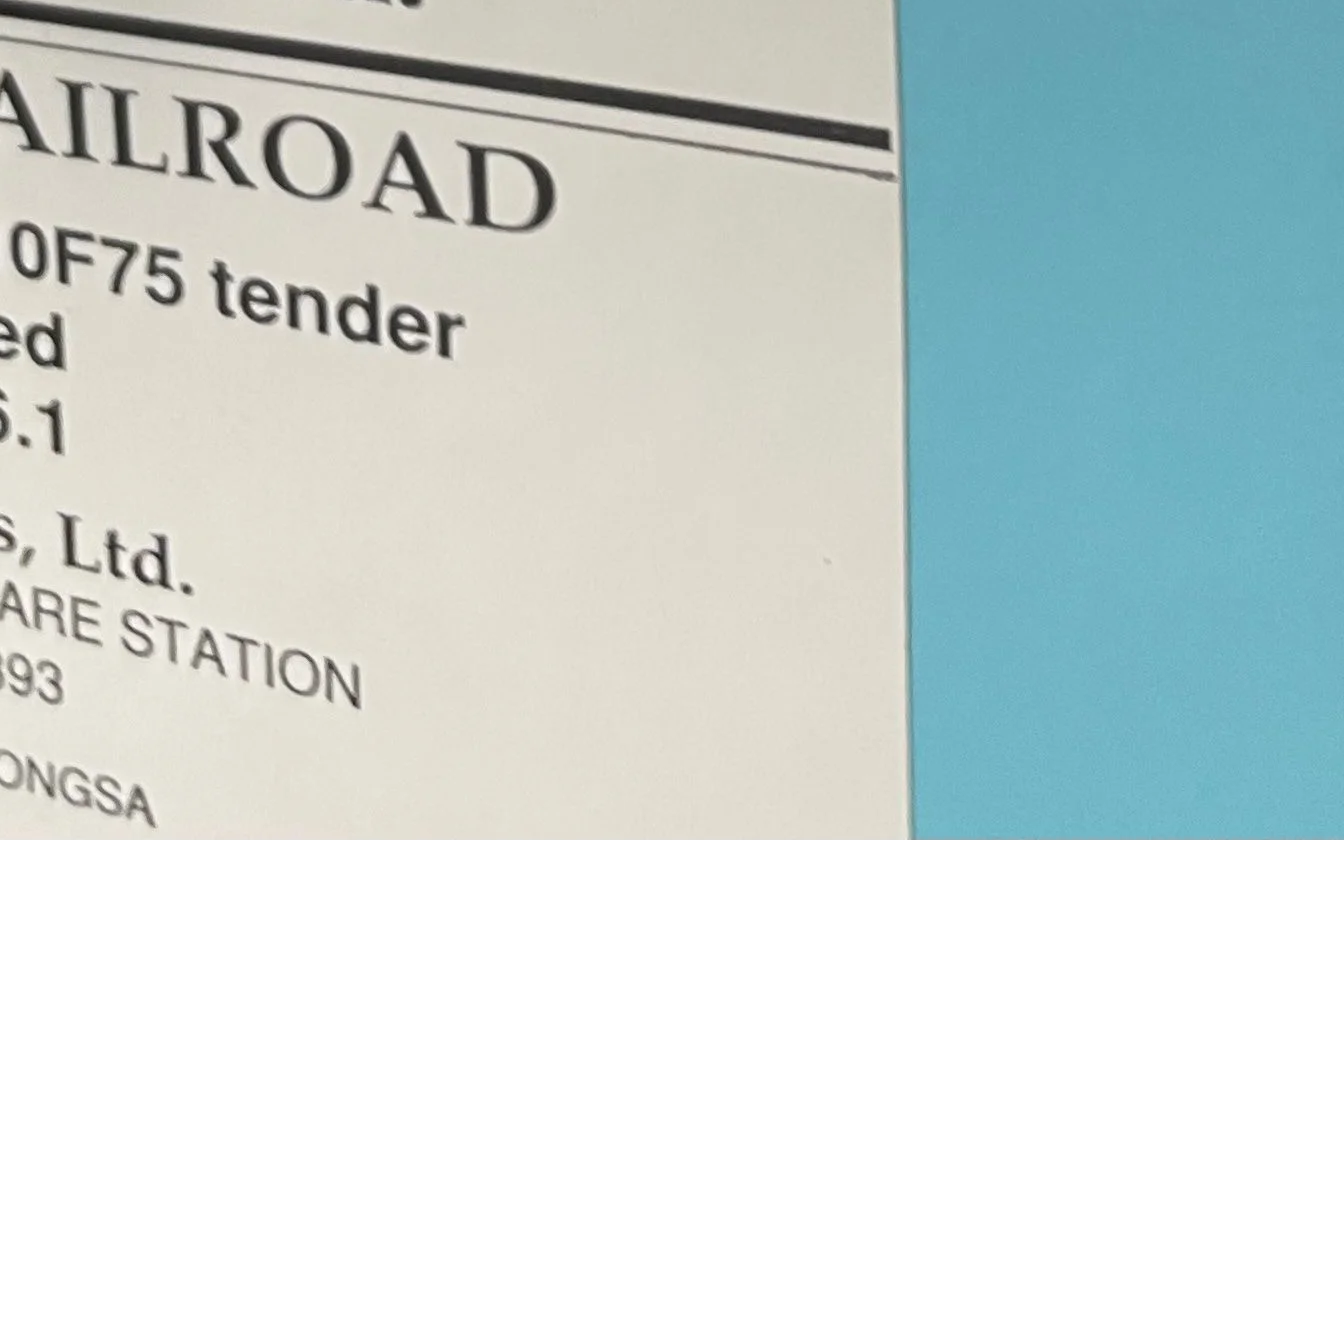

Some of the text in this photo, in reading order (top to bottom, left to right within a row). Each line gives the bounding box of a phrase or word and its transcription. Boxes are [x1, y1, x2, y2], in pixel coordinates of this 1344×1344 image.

[209, 261, 465, 359] tender
[57, 512, 192, 595] Ltd.
[121, 610, 361, 709] STATION
